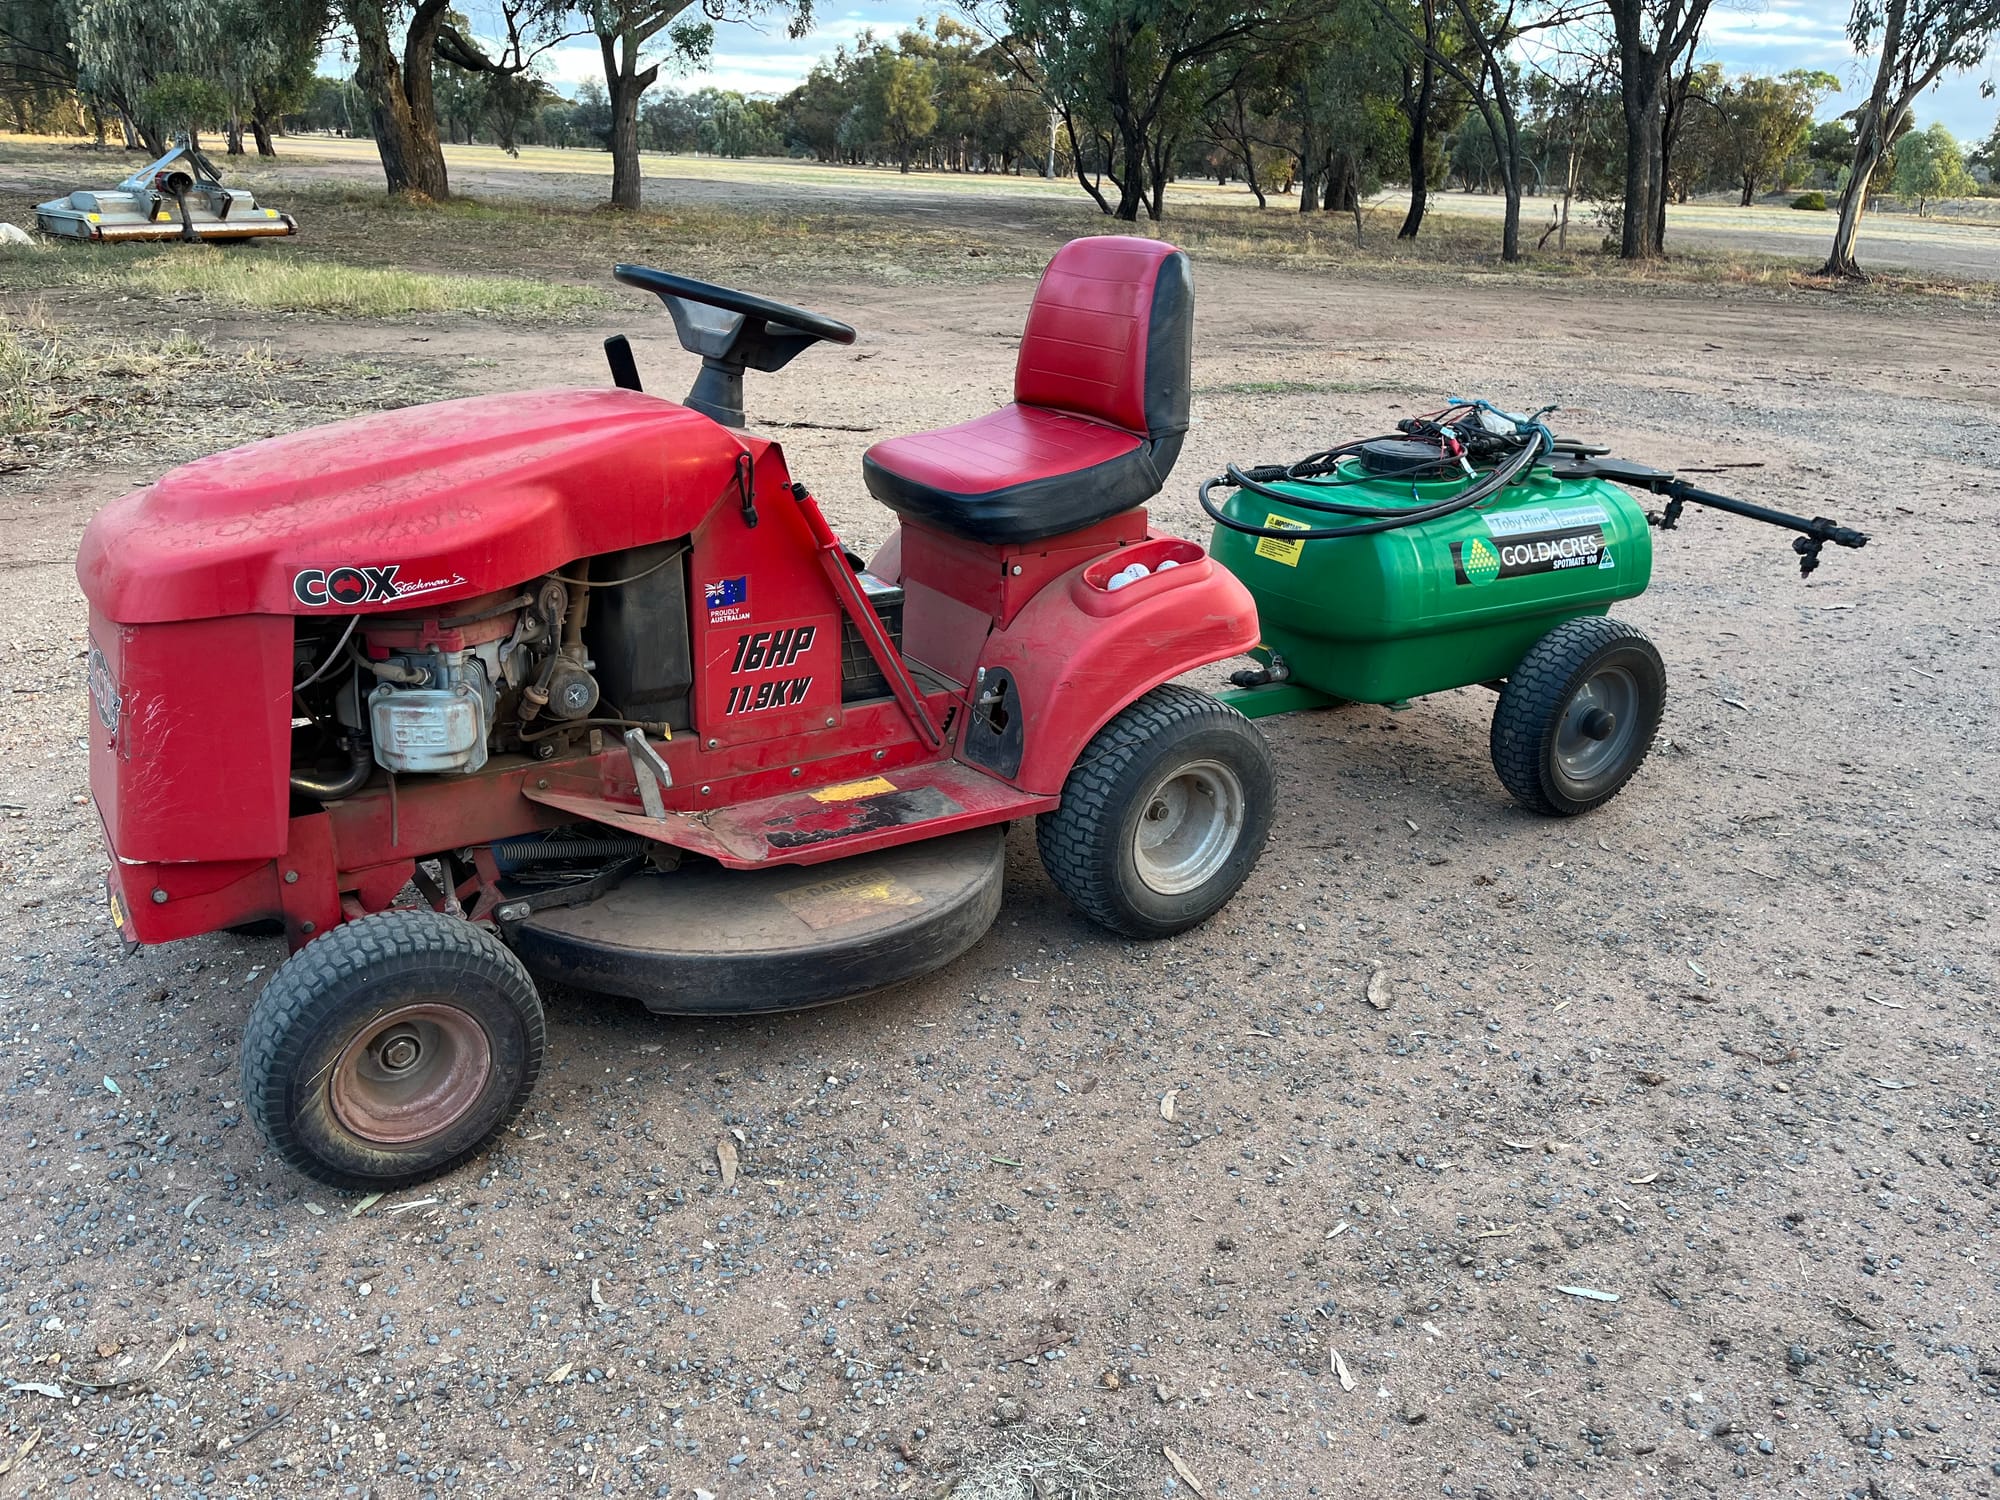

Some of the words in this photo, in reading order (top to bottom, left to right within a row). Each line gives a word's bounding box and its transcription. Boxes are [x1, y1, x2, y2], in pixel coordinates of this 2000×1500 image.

[1501, 535, 1598, 566] GOLDACRES
[1553, 556, 1586, 570] SPOTMATE
[1586, 554, 1598, 565] 100
[293, 565, 400, 606] COX
[394, 578, 450, 595] Stockman
[710, 607, 740, 617] PROUDLY
[710, 612, 751, 624] AUSTRALIAN
[731, 626, 817, 674] 16HP
[726, 676, 813, 716] 11.9KW
[807, 871, 885, 896] DANGER
